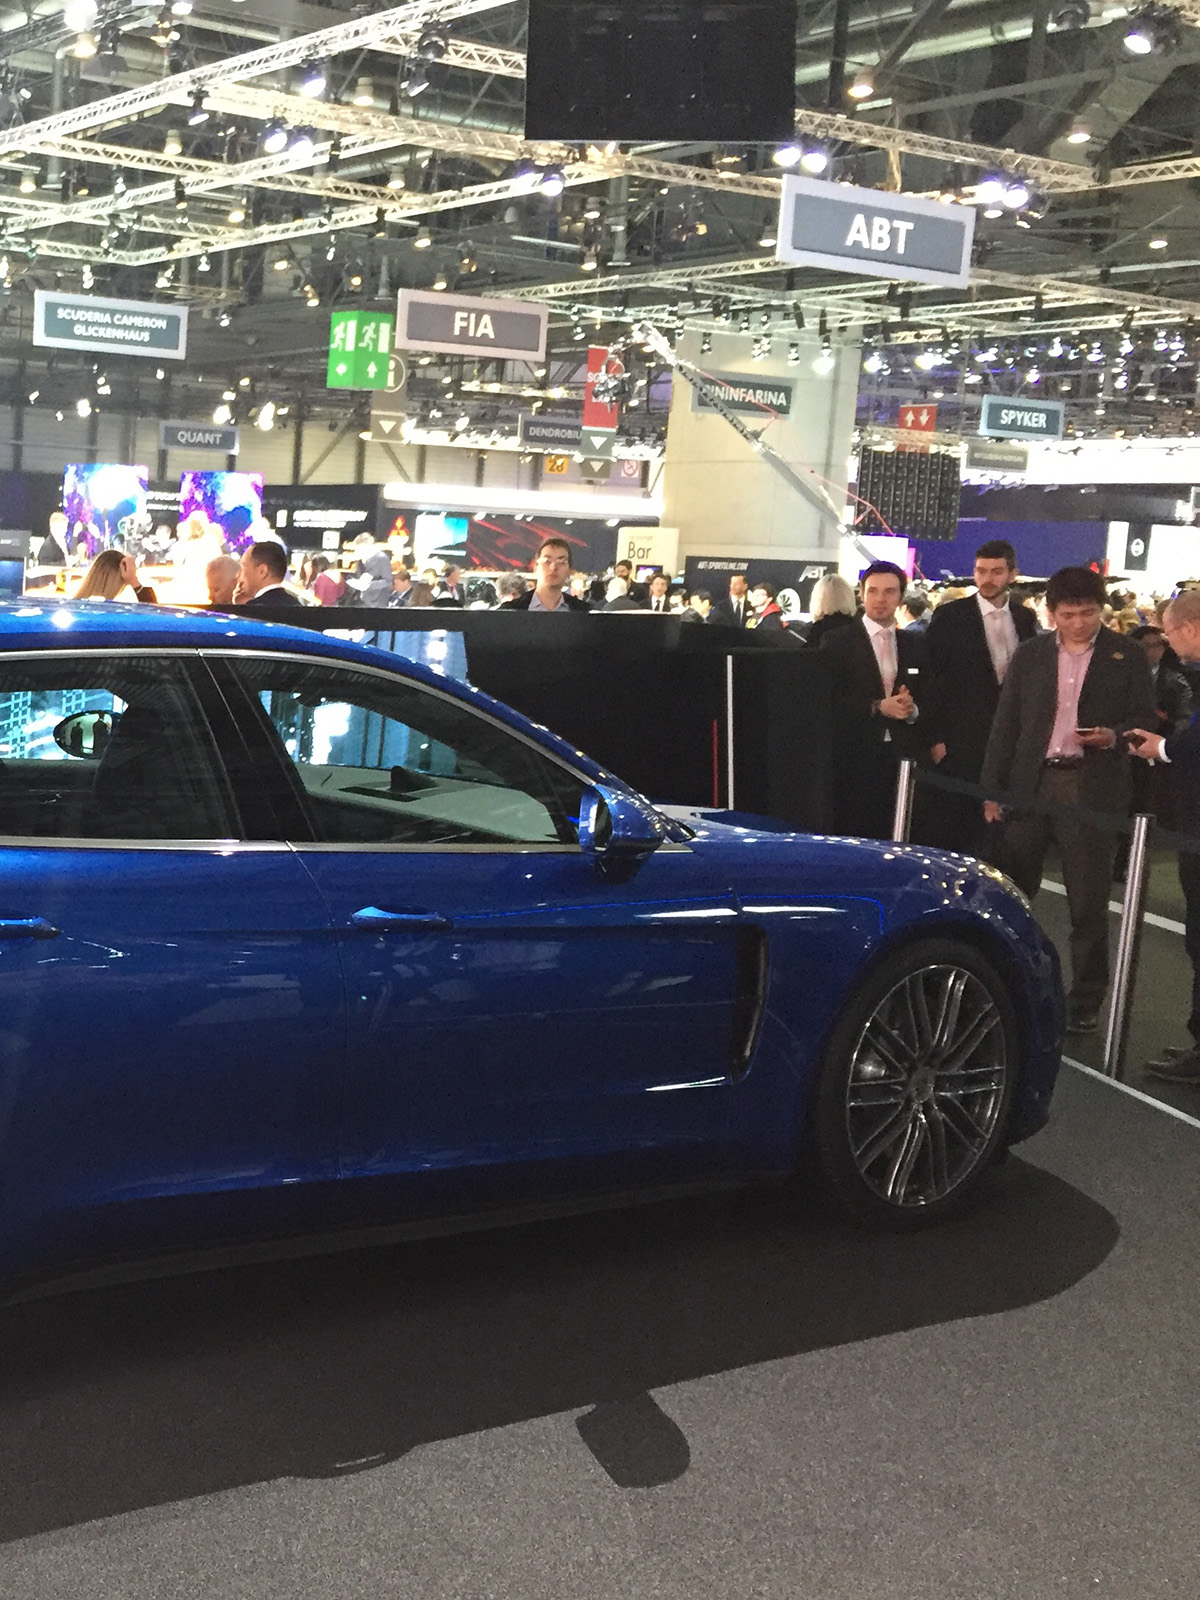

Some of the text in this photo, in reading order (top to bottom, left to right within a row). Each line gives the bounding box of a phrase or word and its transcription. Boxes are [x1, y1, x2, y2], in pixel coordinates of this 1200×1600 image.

[845, 213, 914, 254] ABT
[56, 307, 167, 329] SCUDERIA CAMERON
[453, 311, 495, 339] FIA
[73, 325, 150, 342] GLICKENHAUS
[1000, 409, 1047, 428] SPYKER
[177, 430, 222, 445] QUANT
[627, 541, 652, 559] Bar
[799, 565, 828, 582] ABT
